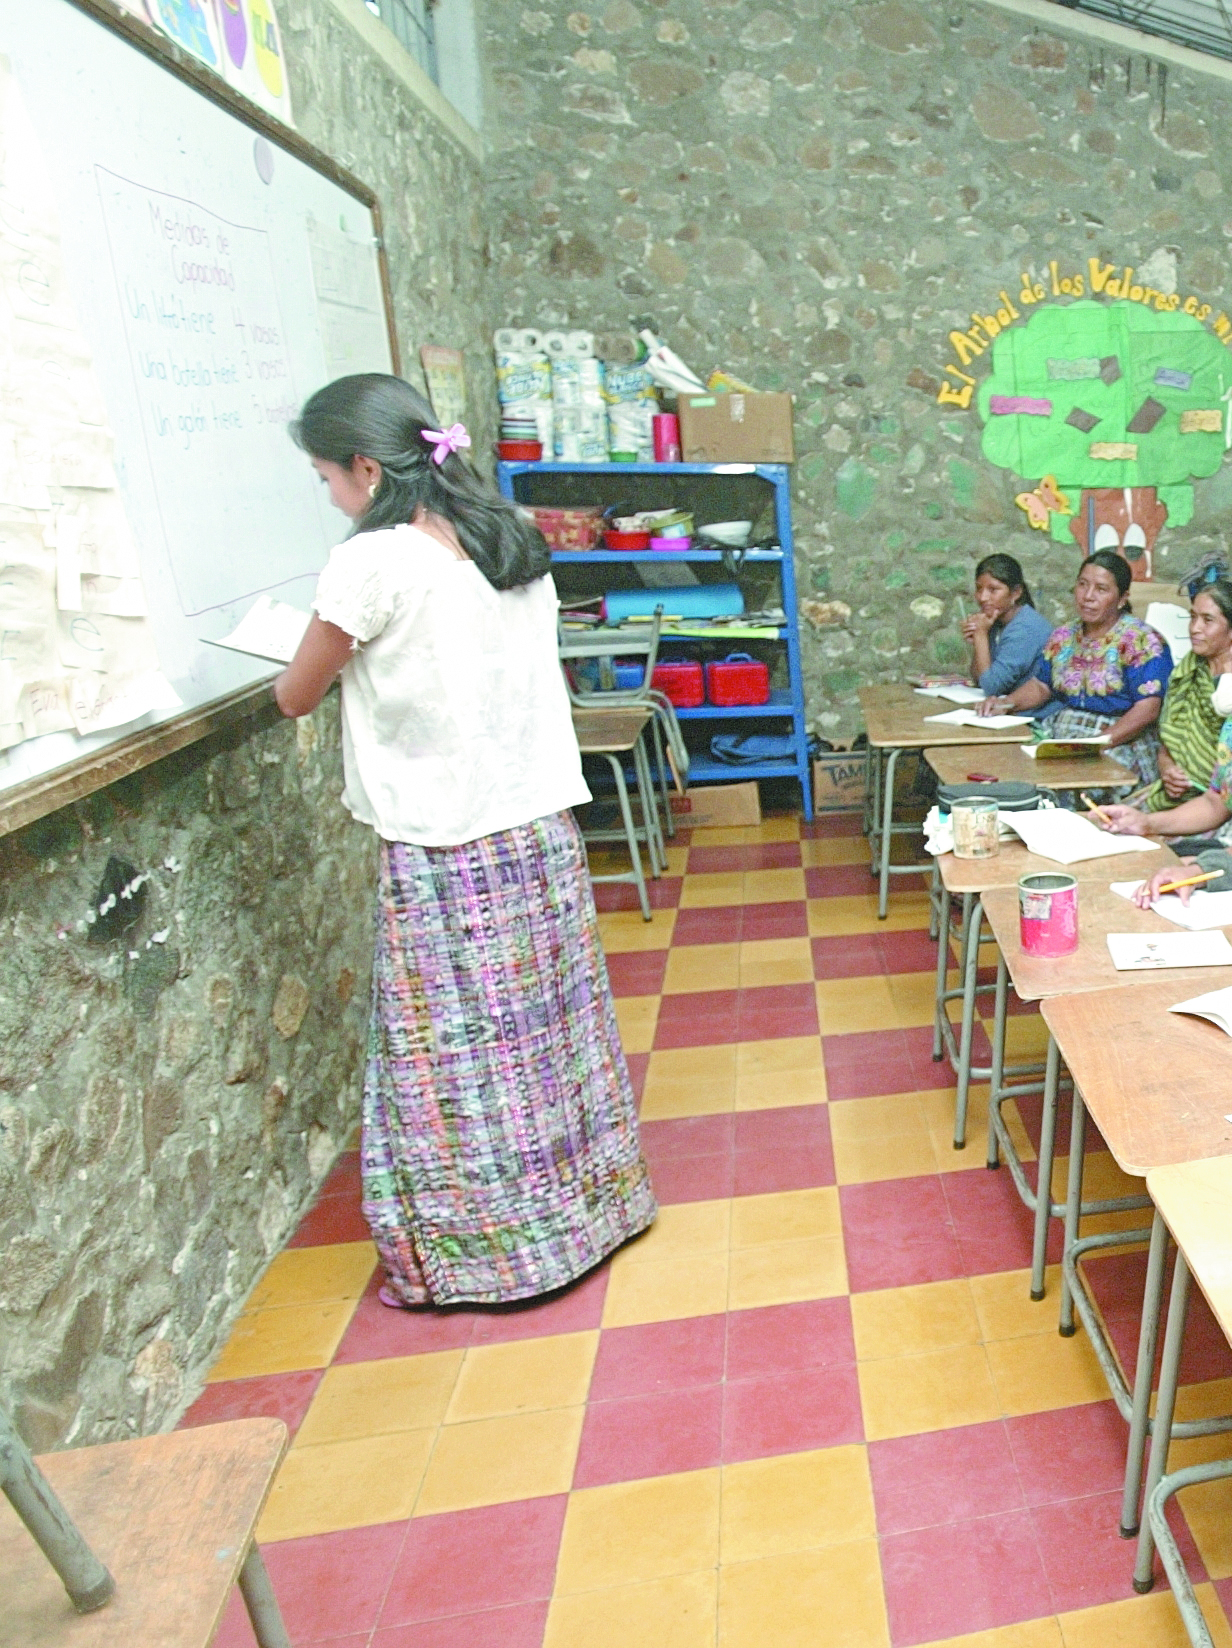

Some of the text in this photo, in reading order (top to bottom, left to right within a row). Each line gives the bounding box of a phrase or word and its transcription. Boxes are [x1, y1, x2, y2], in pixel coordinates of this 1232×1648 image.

[215, 225, 231, 257] de
[1019, 272, 1046, 305] de
[1050, 260, 1085, 297] los
[1087, 257, 1181, 312] Valores
[1183, 295, 1213, 321] es
[949, 289, 1021, 366] Arbol
[937, 363, 977, 409] El
